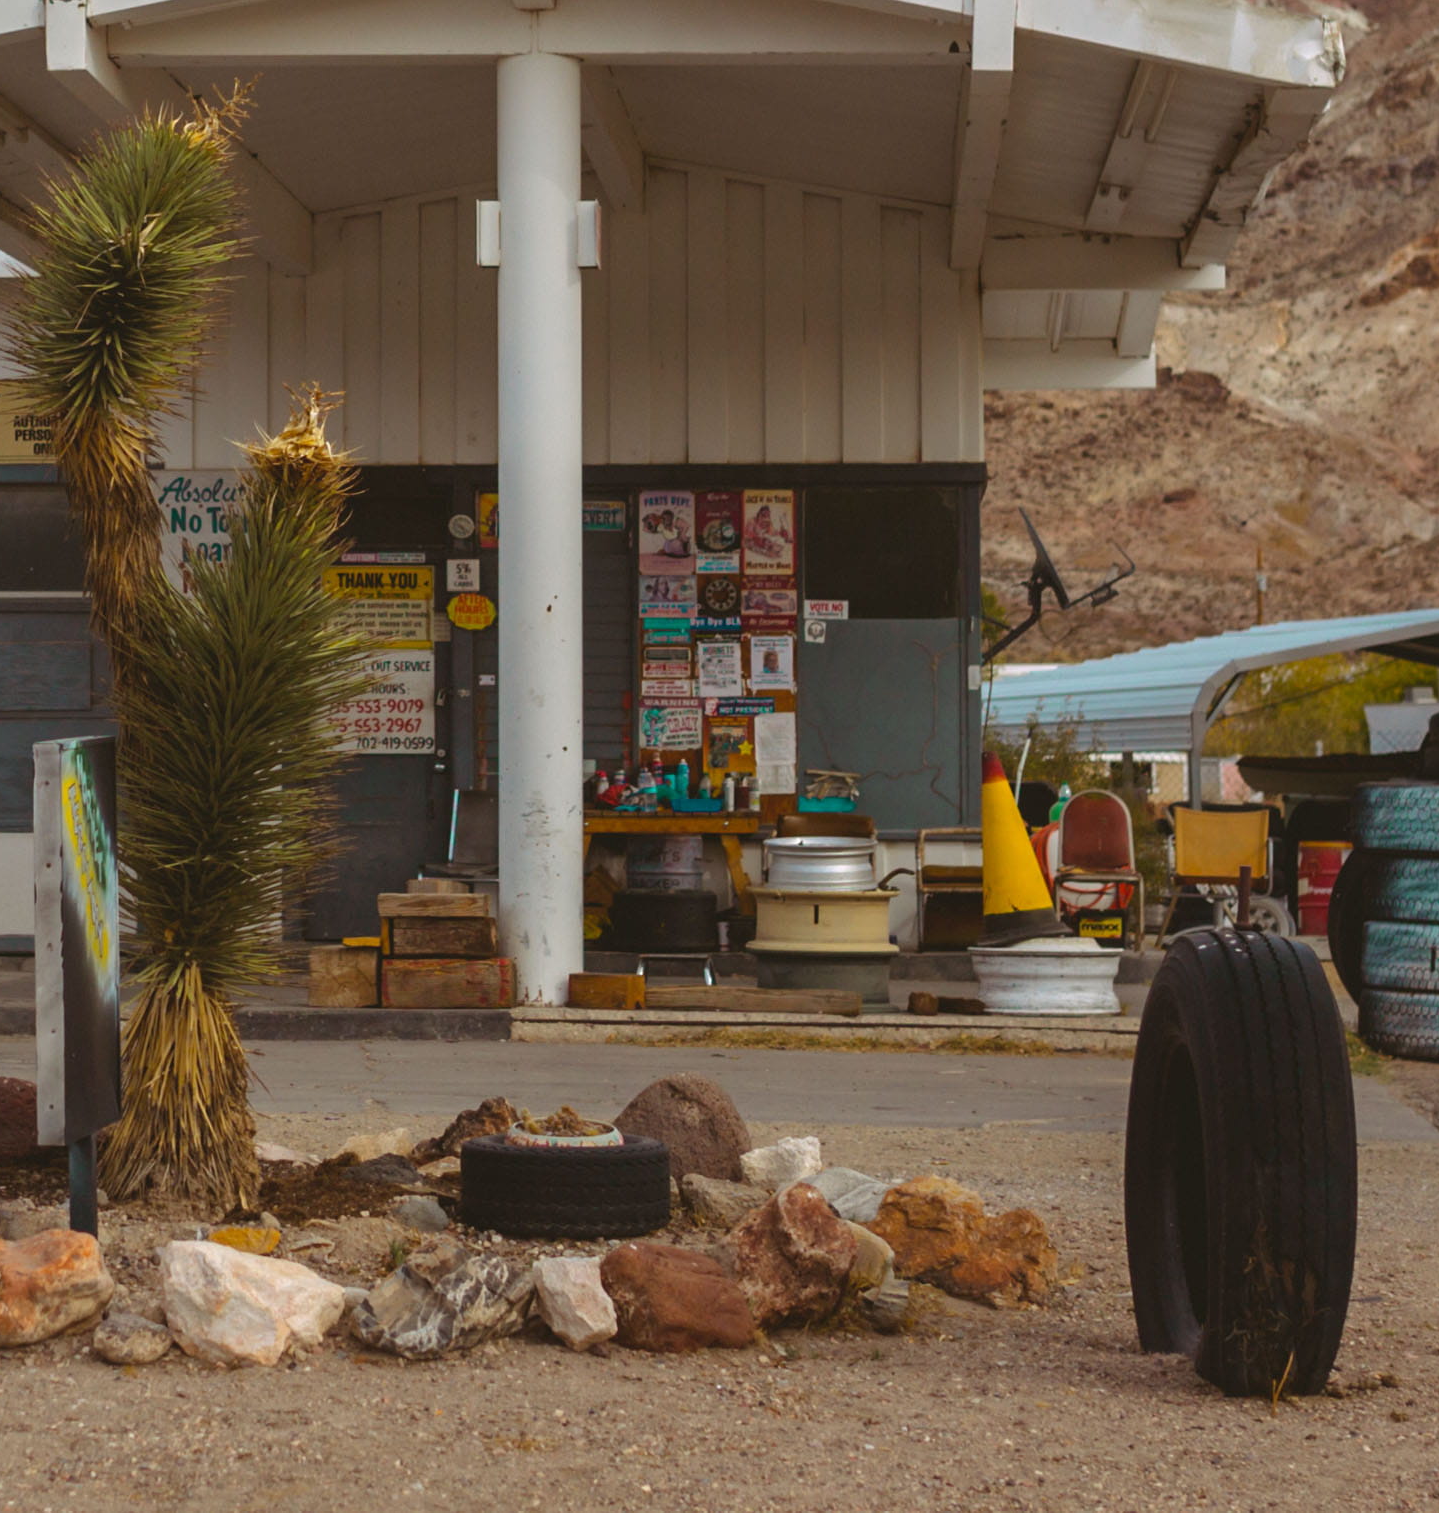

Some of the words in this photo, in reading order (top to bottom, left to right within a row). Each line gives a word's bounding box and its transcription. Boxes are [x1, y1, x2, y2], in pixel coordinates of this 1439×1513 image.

[170, 505, 203, 533] No
[337, 572, 385, 589] THANK
[388, 572, 419, 589] YOU
[371, 660, 391, 672] OUT
[394, 660, 431, 672] SERVICE
